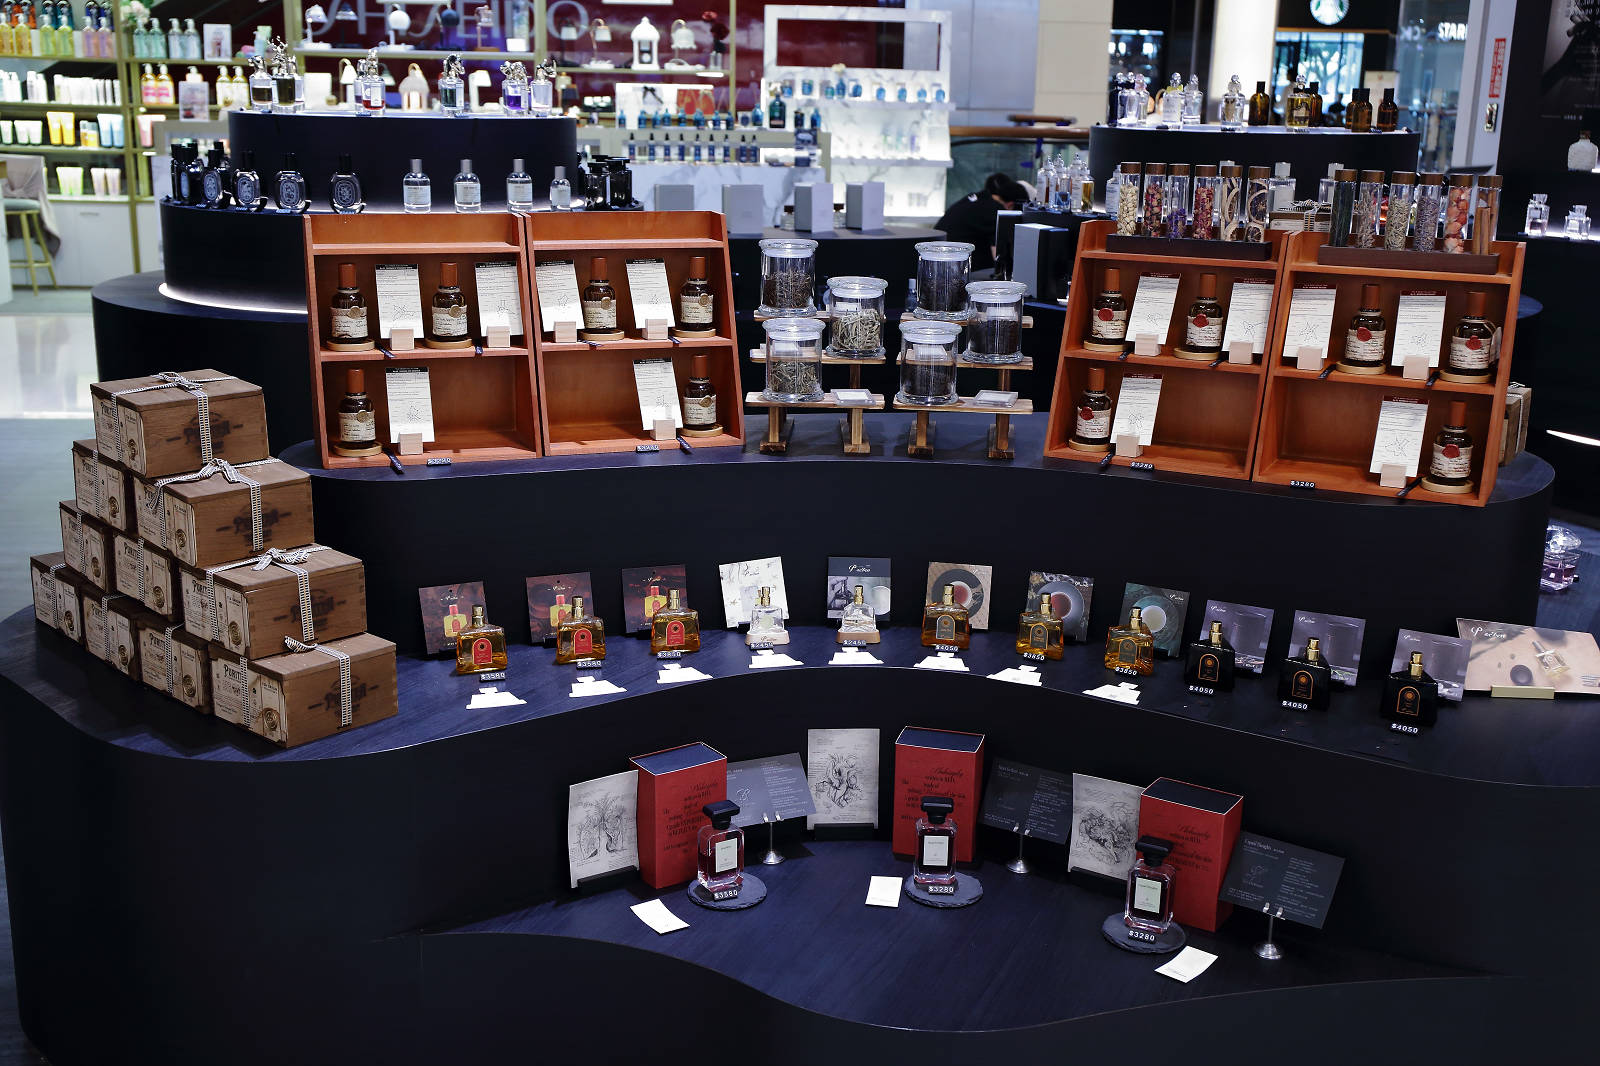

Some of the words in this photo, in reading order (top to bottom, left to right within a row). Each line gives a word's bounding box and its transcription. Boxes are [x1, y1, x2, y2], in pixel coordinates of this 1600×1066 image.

[1438, 21, 1468, 41] STAR
[1290, 480, 1315, 488] $3280
[480, 672, 505, 681] $3580
[1189, 685, 1214, 694] $4050
[1391, 723, 1418, 733] $4050
[1128, 930, 1155, 941] $3280
